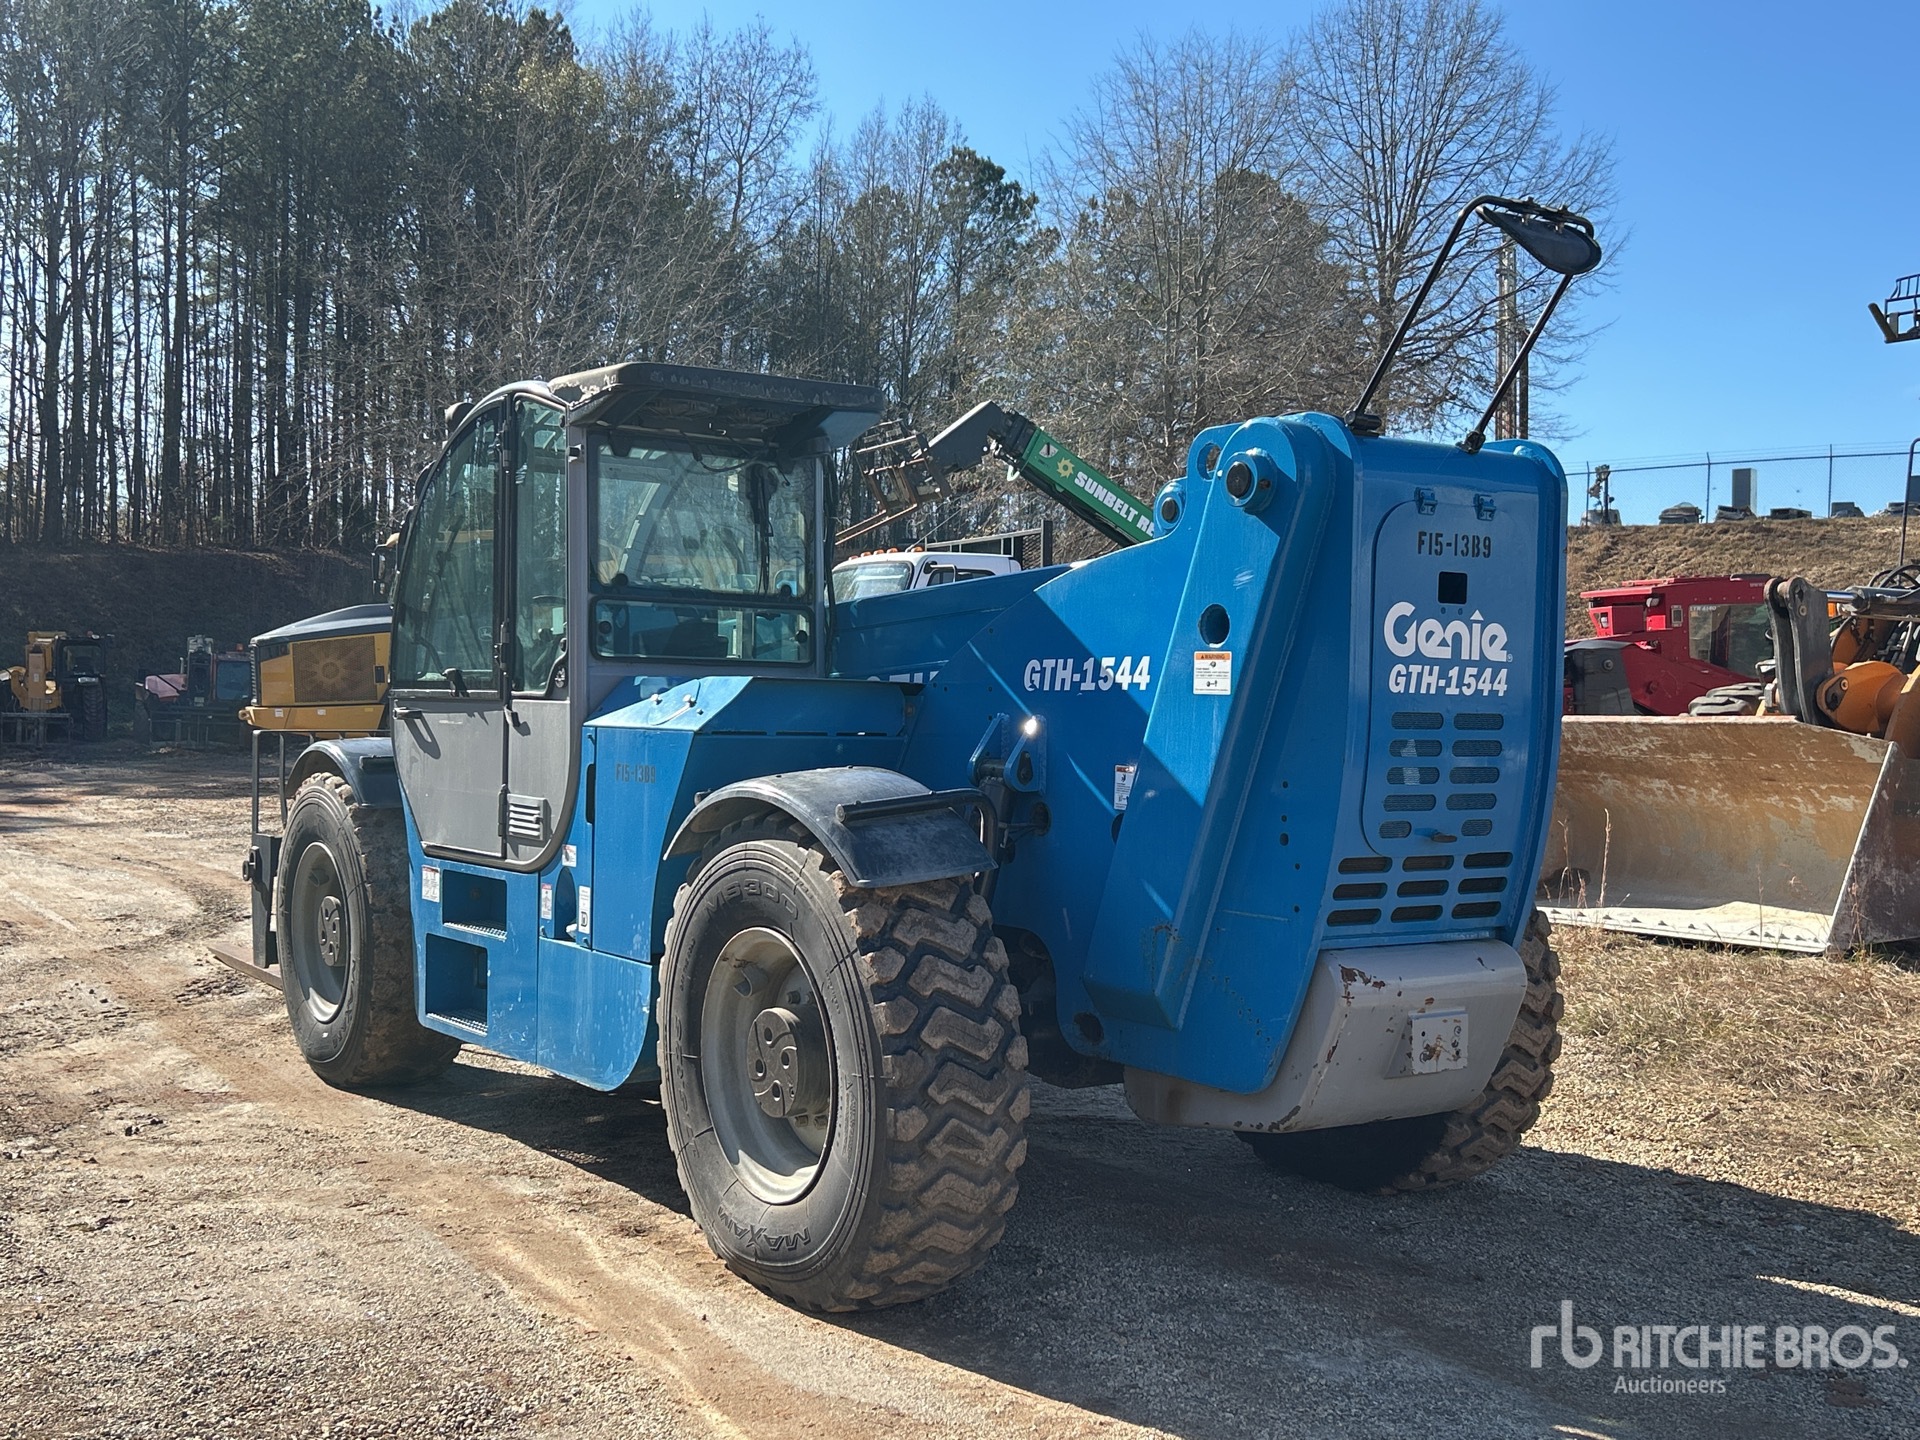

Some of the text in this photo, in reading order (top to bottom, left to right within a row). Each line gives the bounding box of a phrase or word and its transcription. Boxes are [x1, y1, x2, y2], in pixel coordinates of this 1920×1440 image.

[1074, 471, 1138, 522] SUNBELT
[1384, 601, 1508, 662] Genie
[1024, 656, 1151, 691] GTH-1544
[1388, 664, 1508, 696] GTH-1544
[717, 1205, 812, 1251] MAXAM
